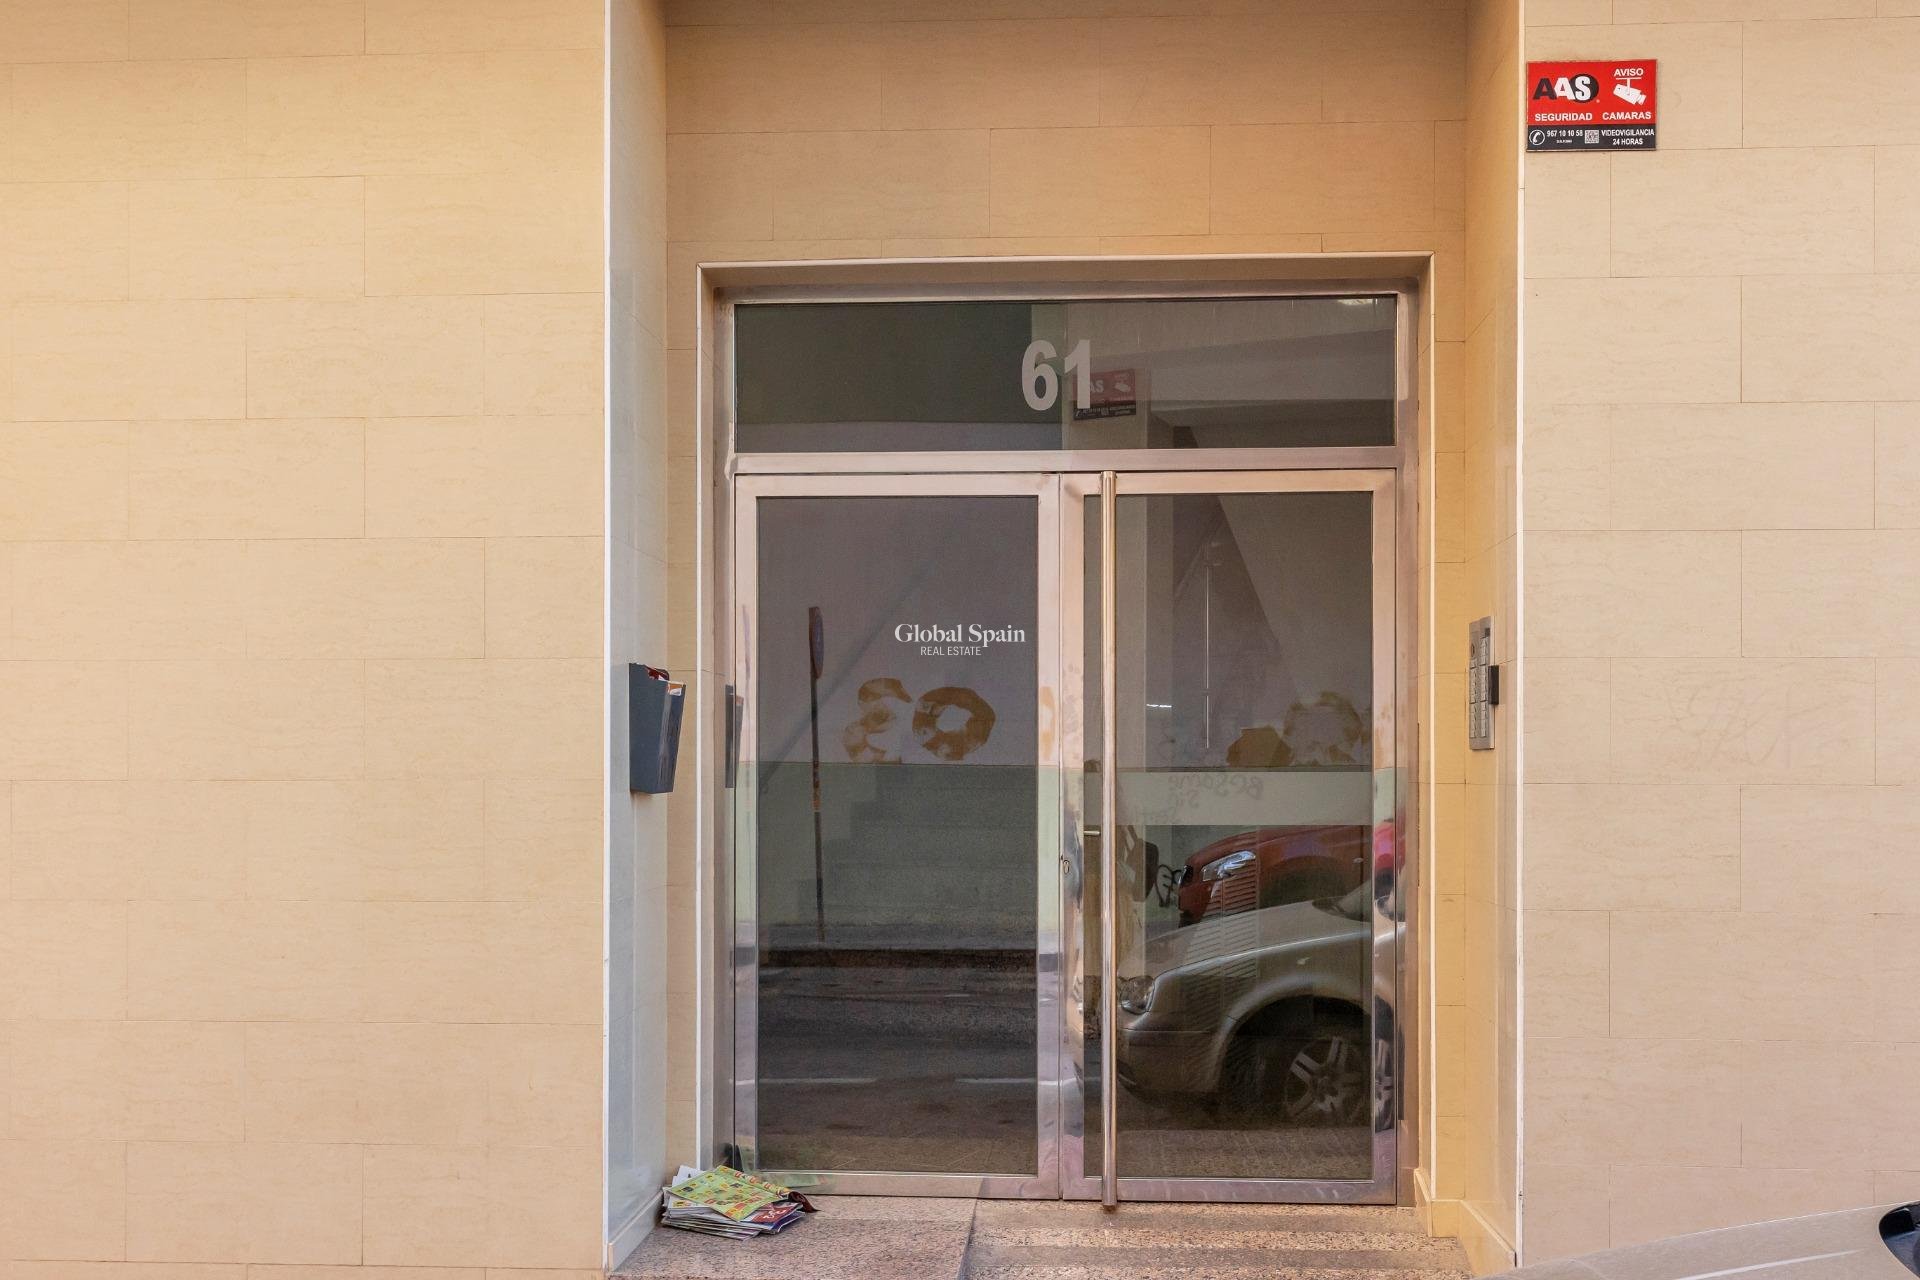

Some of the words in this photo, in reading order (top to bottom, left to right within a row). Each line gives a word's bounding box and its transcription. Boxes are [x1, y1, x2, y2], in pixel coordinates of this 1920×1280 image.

[1613, 68, 1644, 77] AVISO
[1533, 75, 1593, 101] AAS
[1534, 112, 1593, 122] SEGURIDAD
[1602, 111, 1652, 121] CAMARAS
[1546, 129, 1557, 137] 967
[1568, 129, 1575, 137] 10
[1576, 129, 1583, 137] 58
[1601, 128, 1655, 137] VIDEOVIGILANCIA
[1022, 339, 1090, 411] 61
